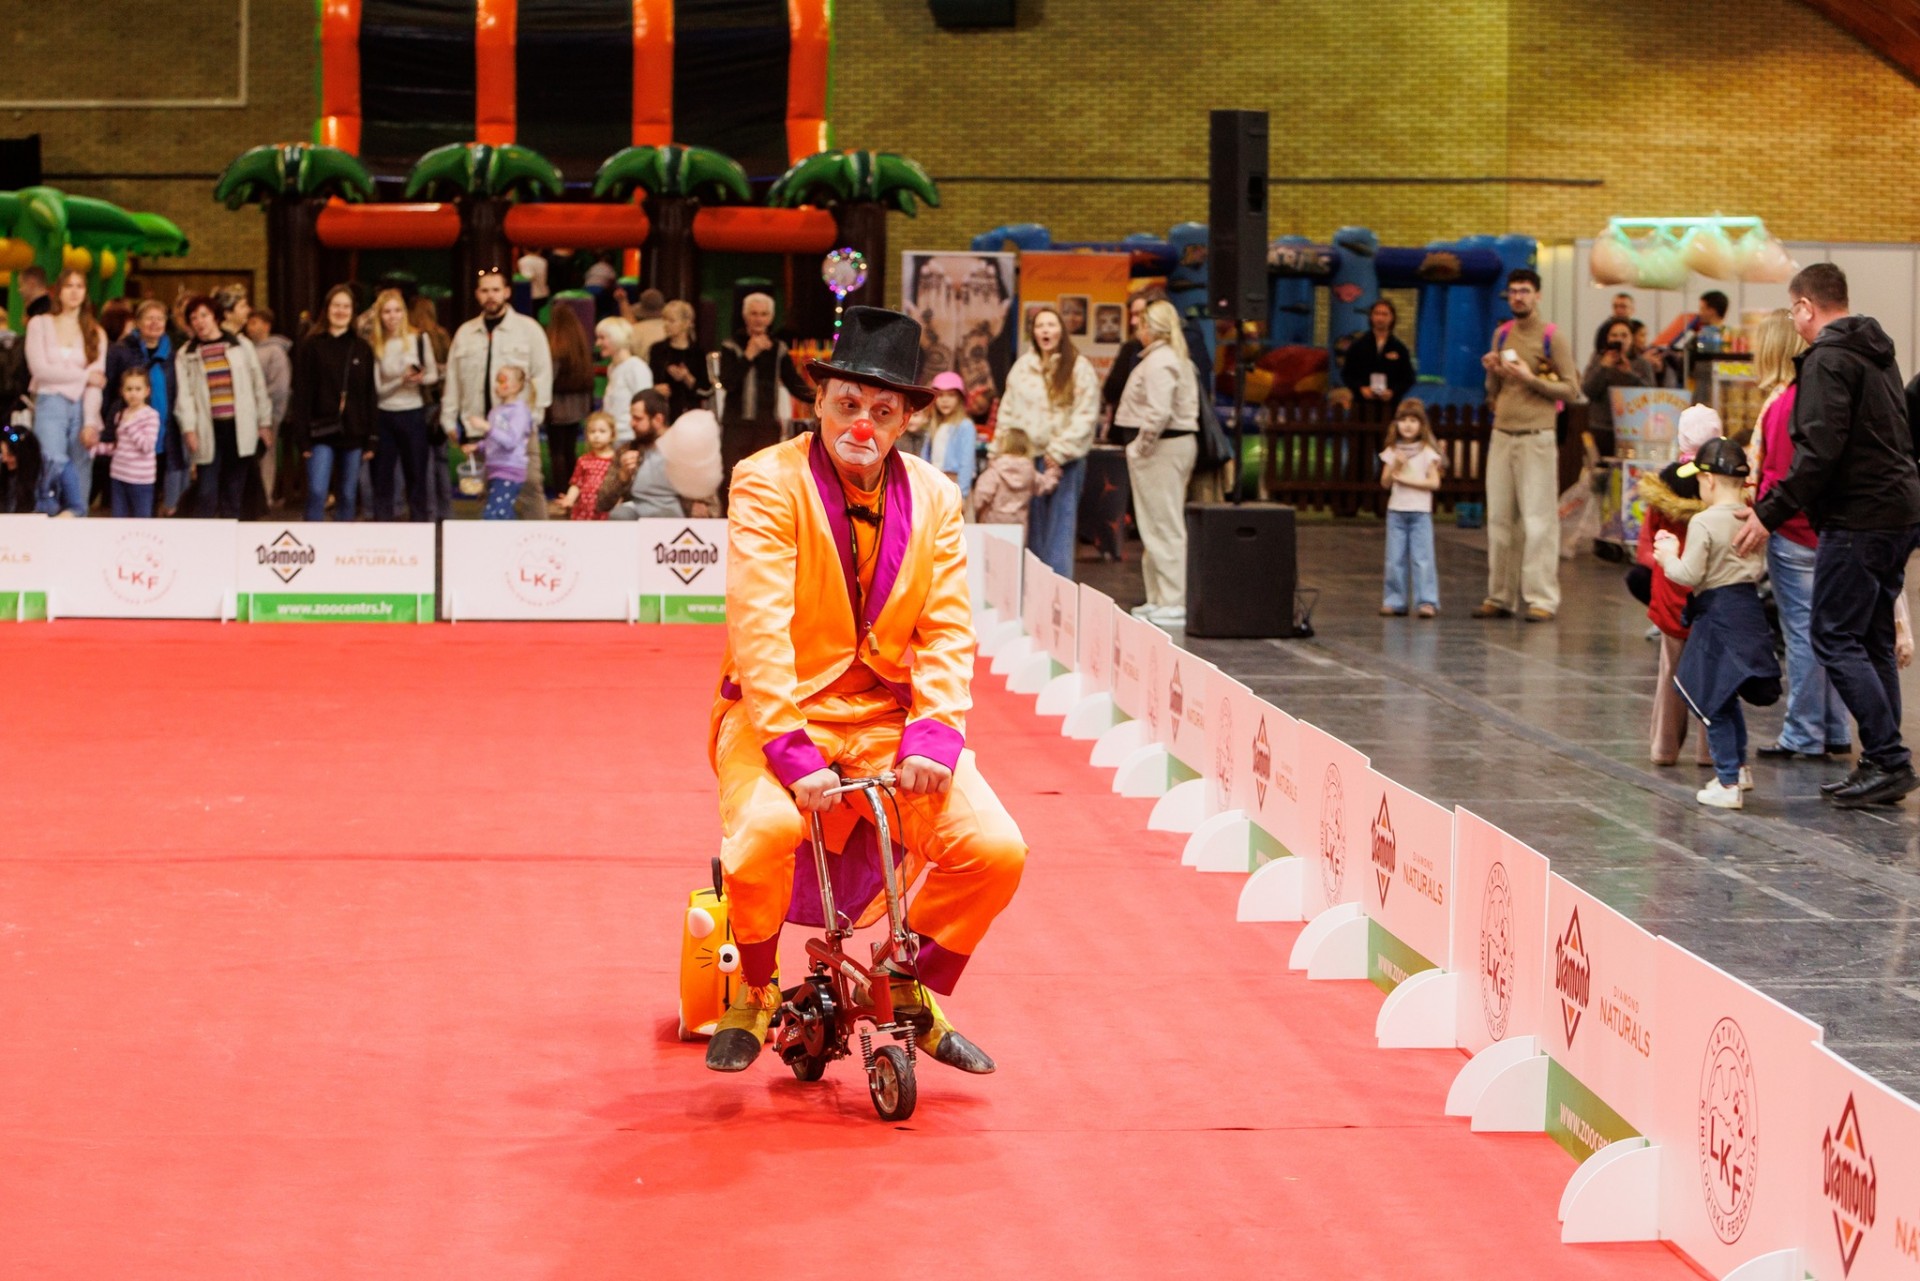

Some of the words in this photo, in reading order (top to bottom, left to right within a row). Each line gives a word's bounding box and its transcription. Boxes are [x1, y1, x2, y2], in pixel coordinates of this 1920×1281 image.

[256, 544, 315, 565] Diamond
[335, 555, 419, 567] NATURALS
[653, 543, 719, 564] Diamond
[118, 565, 159, 589] LKF
[520, 568, 561, 591] LKF
[276, 601, 393, 615] www.zoocentrs.lv
[1325, 829, 1341, 885] LKF
[1403, 862, 1443, 905] NATURALS
[1487, 940, 1506, 1011] LKF
[1555, 933, 1590, 1008] Diamond
[1613, 985, 1640, 1014] DIAMOND
[1600, 996, 1651, 1058] NATURALS
[1711, 1026, 1750, 1078] LATVIJAS
[1710, 1116, 1743, 1207] LKF
[1822, 1126, 1876, 1229] Diamond
